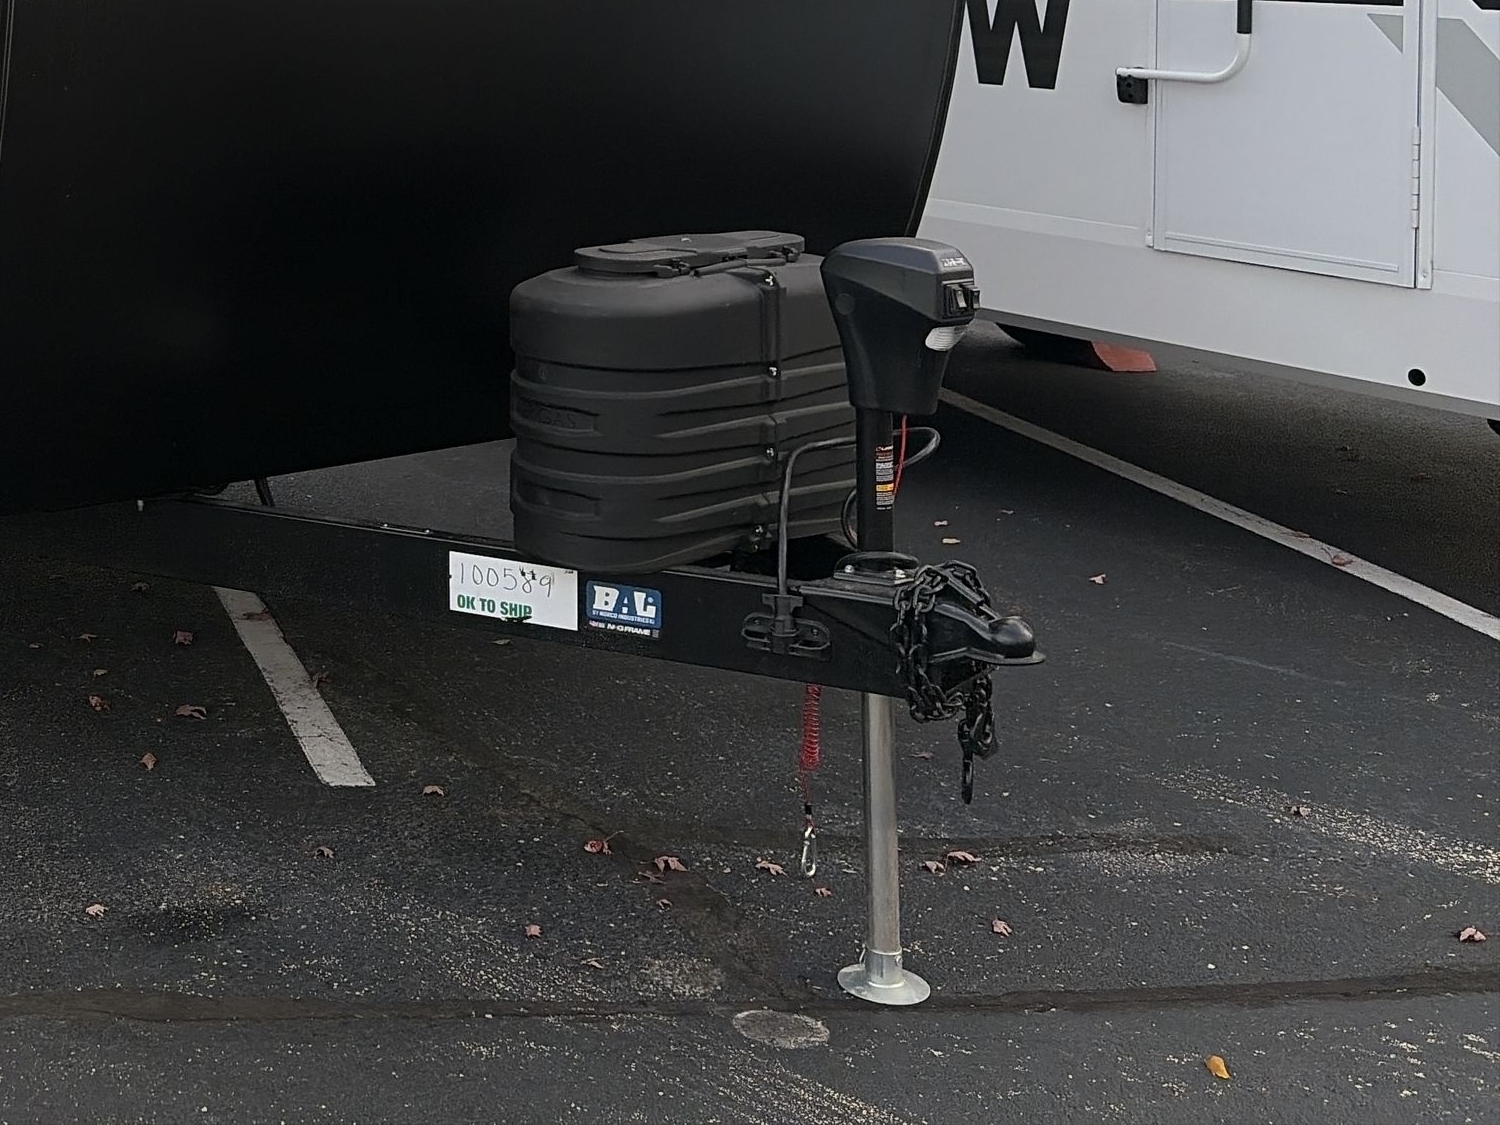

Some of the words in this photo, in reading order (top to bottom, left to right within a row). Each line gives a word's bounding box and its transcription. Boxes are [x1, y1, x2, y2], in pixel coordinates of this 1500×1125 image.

[457, 594, 476, 611] OK
[479, 597, 496, 613] TO
[500, 601, 532, 618] SHIP
[592, 585, 657, 619] BAL
